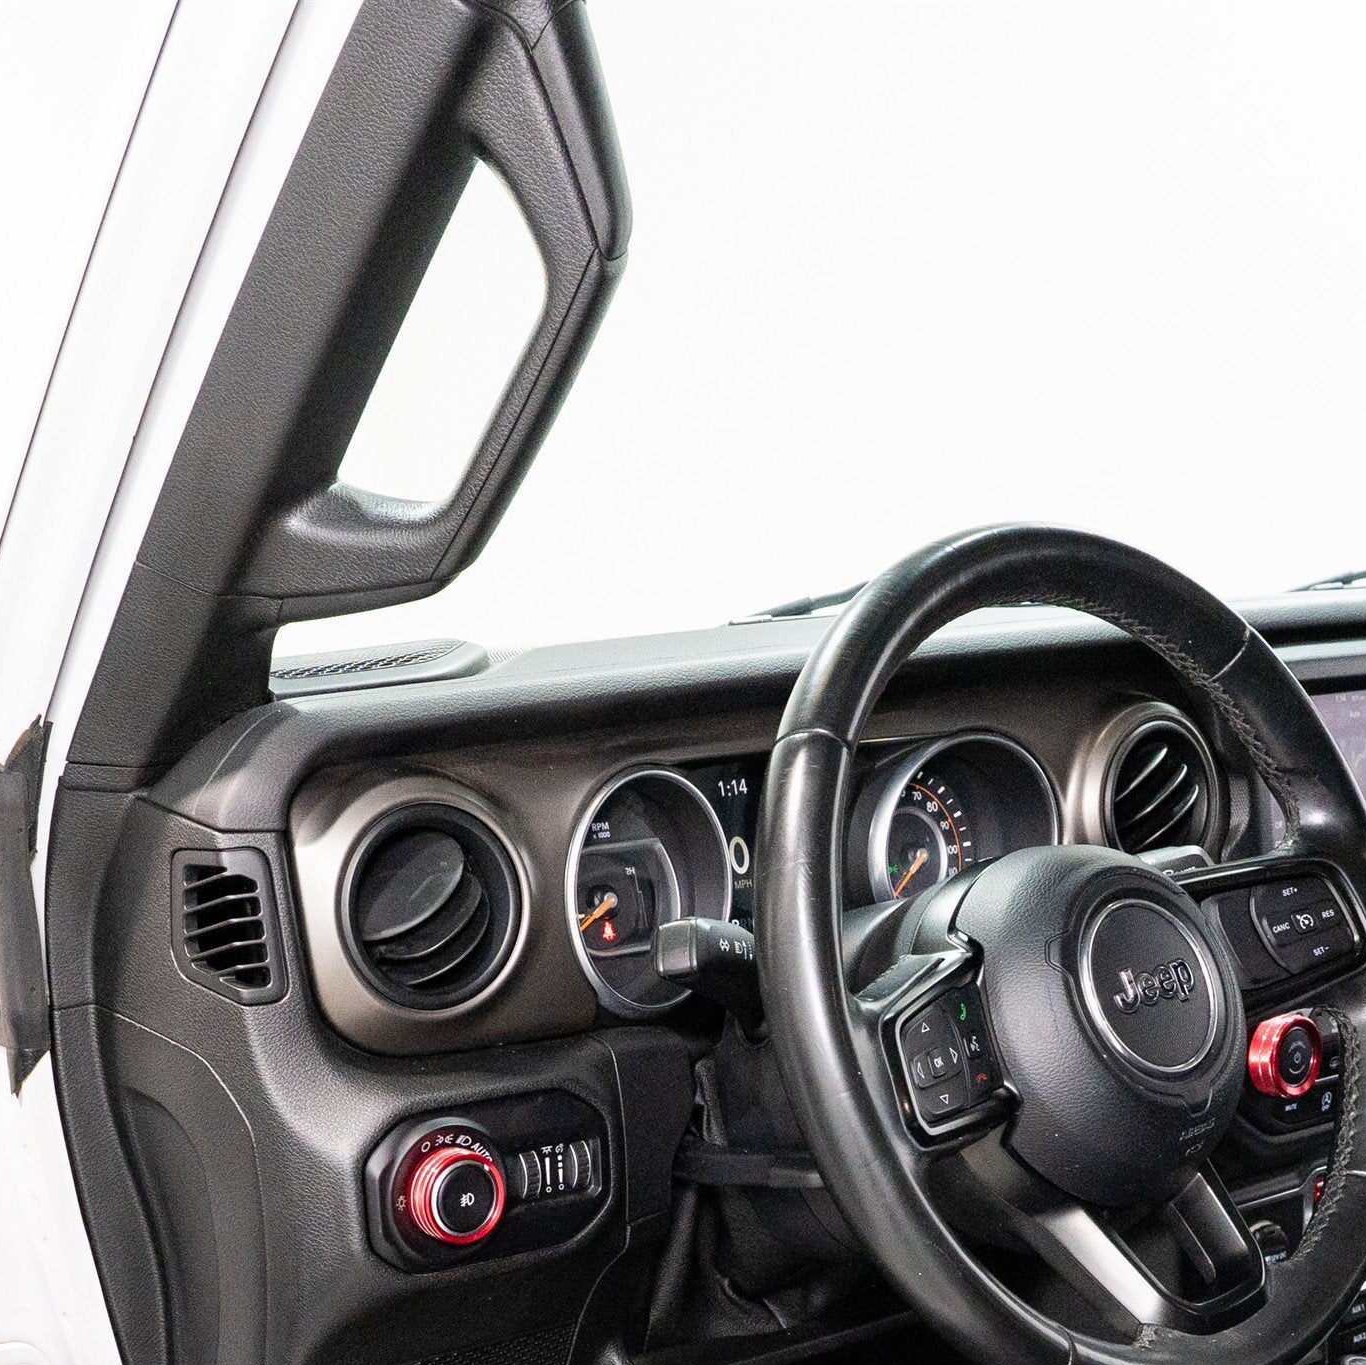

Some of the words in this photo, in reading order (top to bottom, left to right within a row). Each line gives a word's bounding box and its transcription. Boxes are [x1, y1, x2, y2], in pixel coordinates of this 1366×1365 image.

[717, 778, 748, 797] 1:14
[911, 791, 923, 801] 70
[926, 801, 939, 813] 80
[591, 821, 610, 832] RPM
[939, 820, 951, 831] 90
[729, 835, 750, 875] 0
[734, 878, 753, 890] MPH
[1321, 908, 1336, 919] RES
[1272, 921, 1291, 934] CANC
[1113, 958, 1195, 1015] Jeep
[933, 1056, 945, 1068] OK
